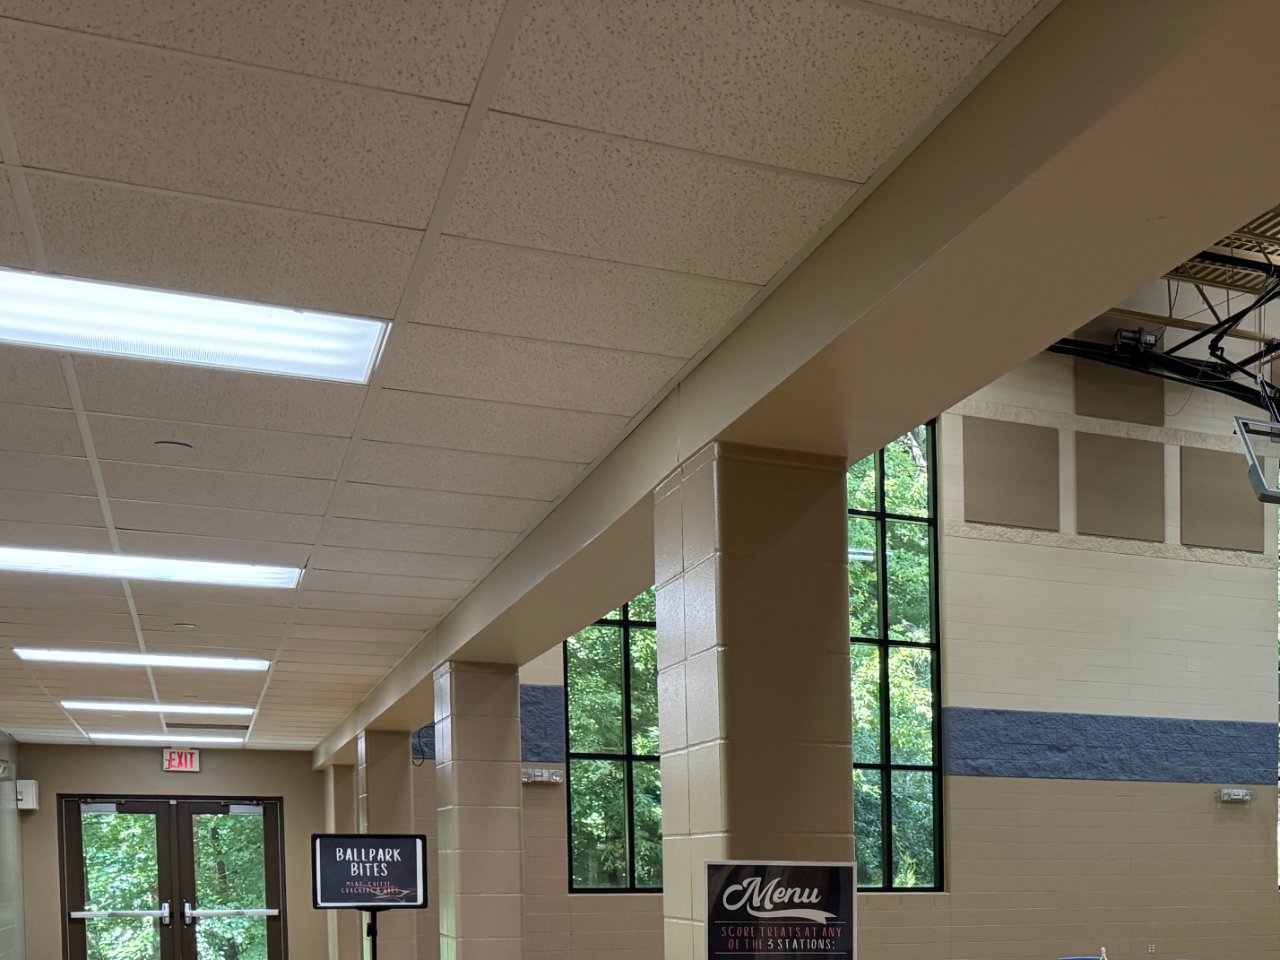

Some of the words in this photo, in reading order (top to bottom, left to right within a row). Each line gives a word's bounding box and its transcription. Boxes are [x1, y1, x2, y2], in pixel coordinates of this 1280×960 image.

[169, 751, 195, 769] EXIT
[336, 847, 402, 862] BALLPARK
[350, 862, 388, 877] BITES
[722, 876, 822, 911] Menu
[721, 926, 755, 937] SCORE
[760, 926, 801, 937] TREATS
[805, 926, 817, 937] AT
[822, 926, 842, 937] ANY
[728, 939, 739, 950] OF
[745, 939, 764, 950] THE
[767, 939, 774, 950] 3
[777, 939, 836, 950] STATIONS:
